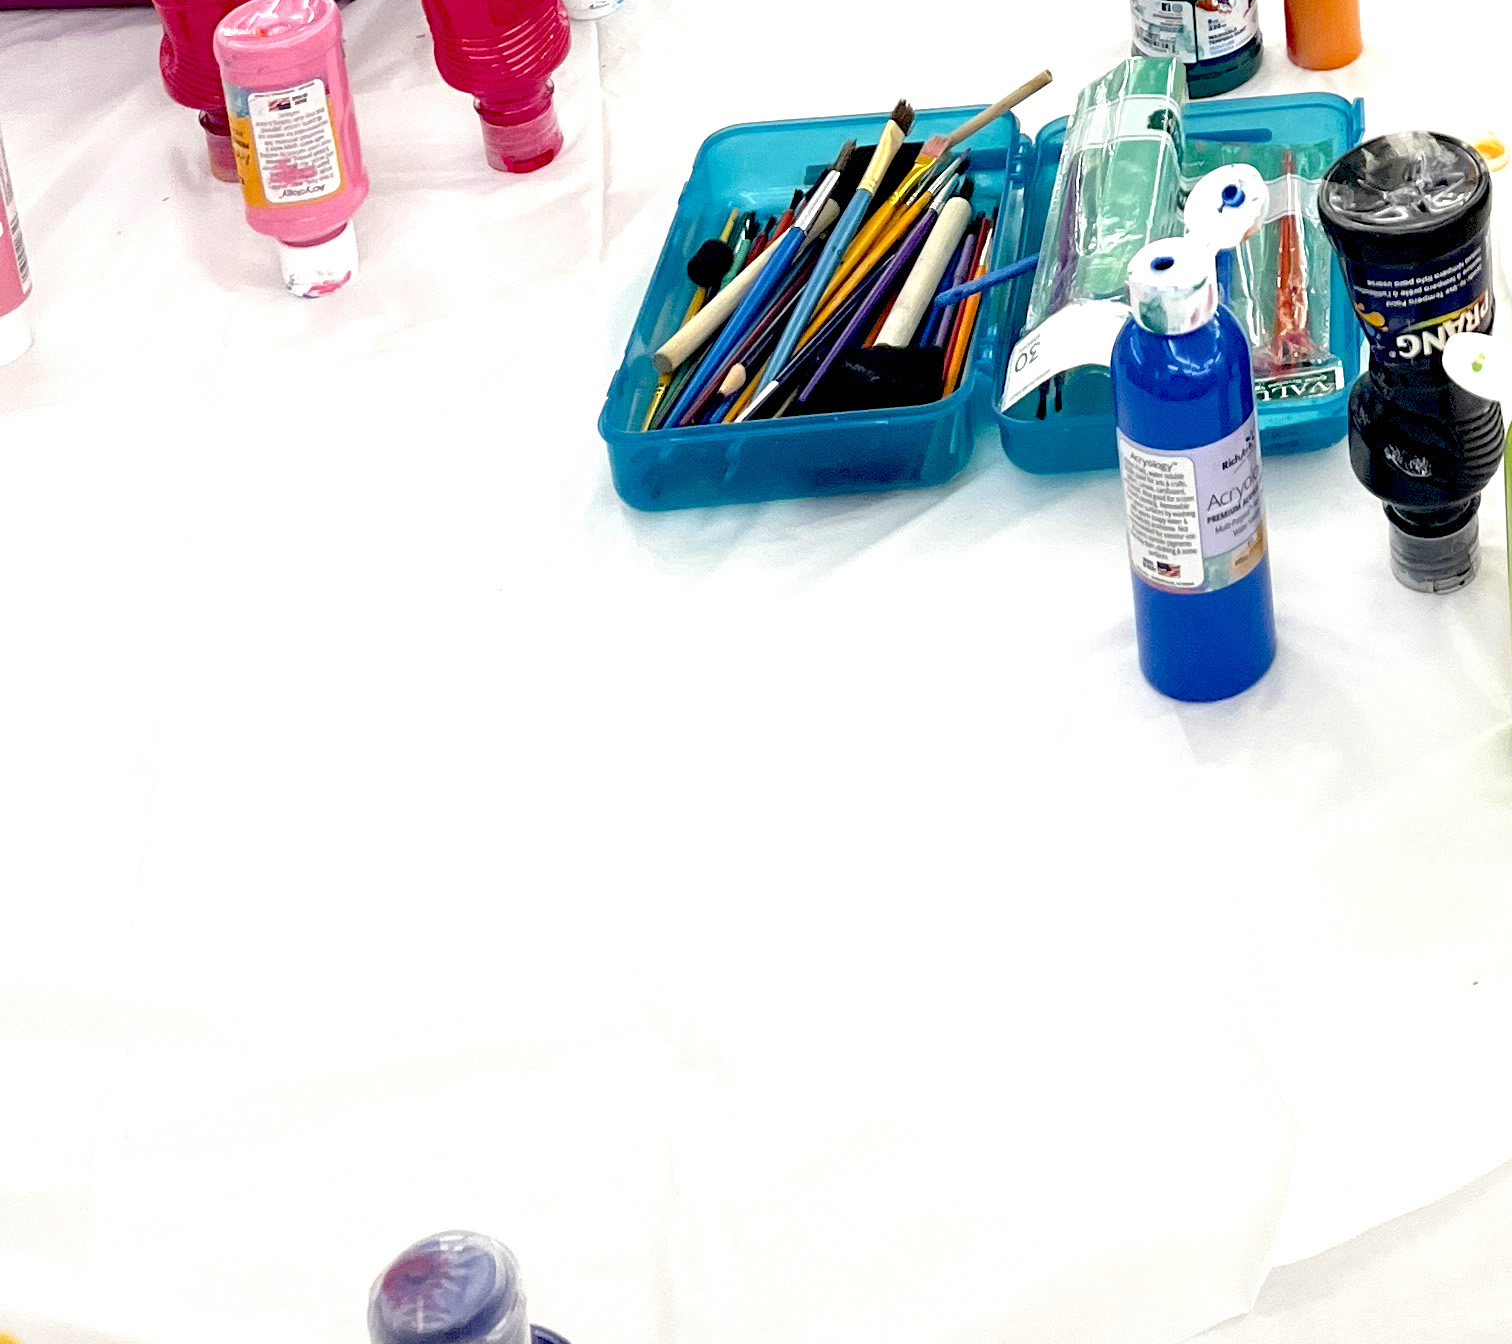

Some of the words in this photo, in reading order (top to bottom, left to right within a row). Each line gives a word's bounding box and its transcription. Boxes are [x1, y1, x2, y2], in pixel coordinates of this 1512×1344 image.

[1396, 288, 1489, 359] PRANG
[1014, 341, 1040, 372] 30
[1207, 503, 1242, 525] PREMIUM
